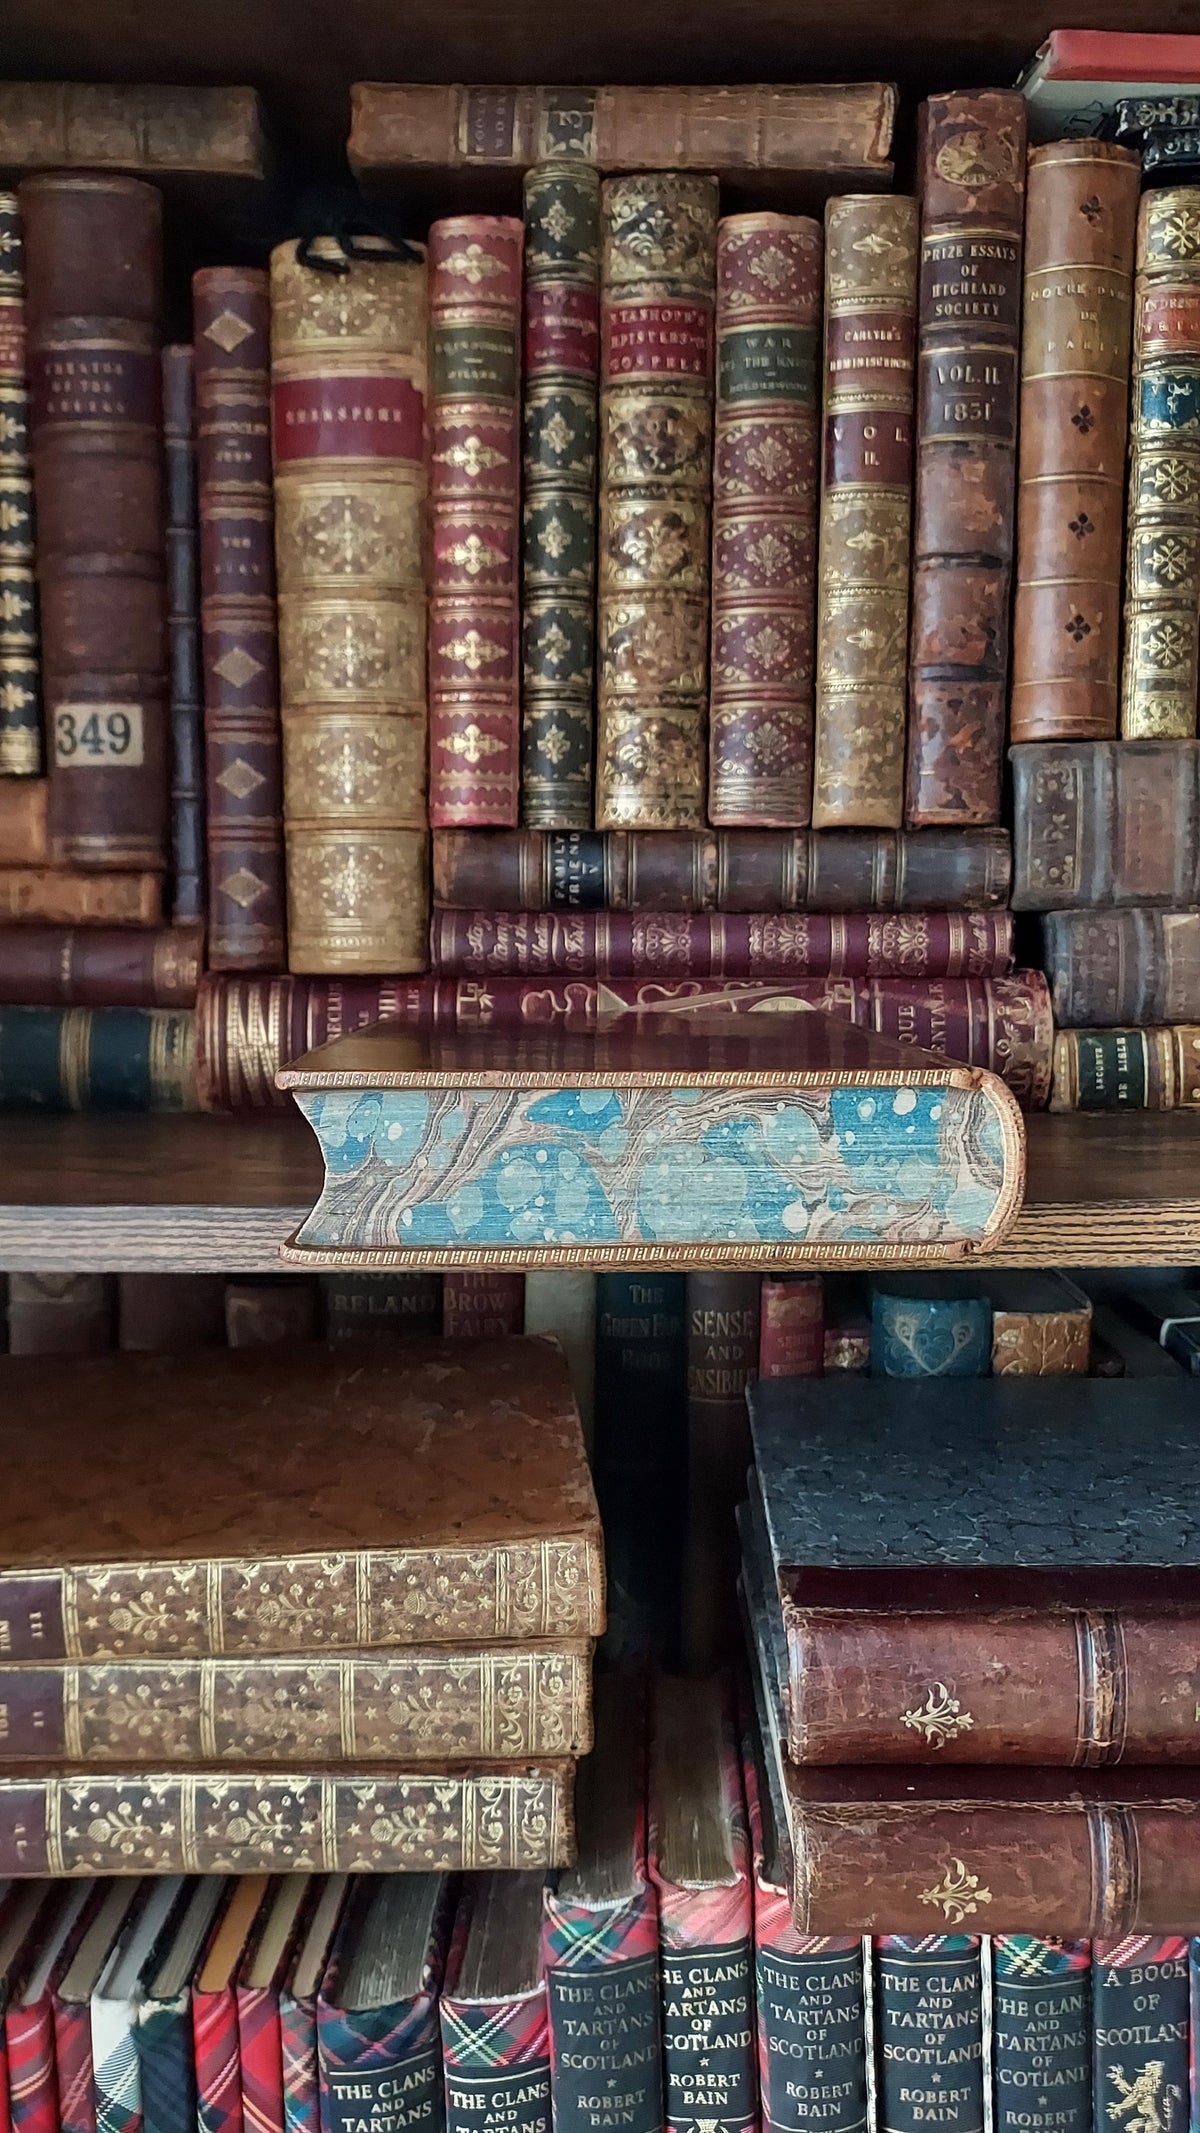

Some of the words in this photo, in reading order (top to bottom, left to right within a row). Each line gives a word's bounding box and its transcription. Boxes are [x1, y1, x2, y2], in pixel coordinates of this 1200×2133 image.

[923, 245, 964, 262] PRIZE
[970, 244, 1017, 261] ESSAYS
[961, 264, 979, 277] OF
[932, 281, 1007, 298] HIGHLAND
[935, 302, 999, 317] SOCIETY
[943, 402, 991, 421] 1851
[57, 711, 131, 757] 349
[554, 835, 566, 899] FAMILY
[569, 832, 580, 905] FRIEND
[444, 1287, 508, 1313] BROW
[628, 1284, 665, 1305] THE
[692, 1310, 754, 1339] SENSE
[705, 1345, 744, 1361] AND
[663, 1969, 684, 1985] HE
[688, 1960, 749, 1984] CLANS
[763, 1965, 799, 1991] THE
[806, 1967, 861, 1992] CLANS
[1103, 1968, 1124, 1987] A
[1129, 1960, 1188, 1985] BOOK
[881, 1973, 920, 1992] THE
[926, 1974, 980, 1993] CLAN
[555, 1984, 593, 2003] THE
[681, 1987, 717, 1999] AND
[798, 1994, 833, 2006] AND
[593, 2002, 626, 2016] AND
[663, 1996, 747, 2017] ARTANS
[917, 1997, 953, 2009] AND
[1034, 1994, 1085, 2017] CLAN
[1133, 1994, 1161, 2012] OF
[769, 2002, 860, 2026] TARTANS
[886, 2007, 980, 2030] TARTANS
[562, 2011, 654, 2037] TARTANS
[691, 2019, 712, 2031] OF
[1025, 2020, 1060, 2032] AND
[663, 2031, 751, 2051] COTLAND
[806, 2029, 828, 2041] OF
[924, 2033, 947, 2045] OF
[996, 2030, 1086, 2052] TARTANS
[600, 2039, 620, 2051] OF
[769, 2036, 863, 2061] SCOTLAND
[883, 2042, 981, 2065] SCOTLAND
[560, 2045, 658, 2071] SCOTLAND
[1032, 2056, 1054, 2068] OF
[332, 2084, 373, 2101] THE
[377, 2065, 436, 2098] CLANS
[669, 2073, 741, 2088] ROBERT
[449, 2089, 486, 2110] THE
[491, 2080, 550, 2108] CLANS
[577, 2089, 645, 2109] ROBERT
[682, 2091, 728, 2105] BAIN
[785, 2081, 853, 2100] ROBERT
[900, 2087, 971, 2104] ROBERT
[371, 2097, 405, 2114] AND
[796, 2102, 842, 2117] BAIN
[912, 2106, 959, 2121] BAIN
[341, 2100, 433, 2133] TARTANS
[483, 2110, 518, 2124] AND
[590, 2110, 635, 2127] BAIN
[1005, 2109, 1078, 2127] ROBERT
